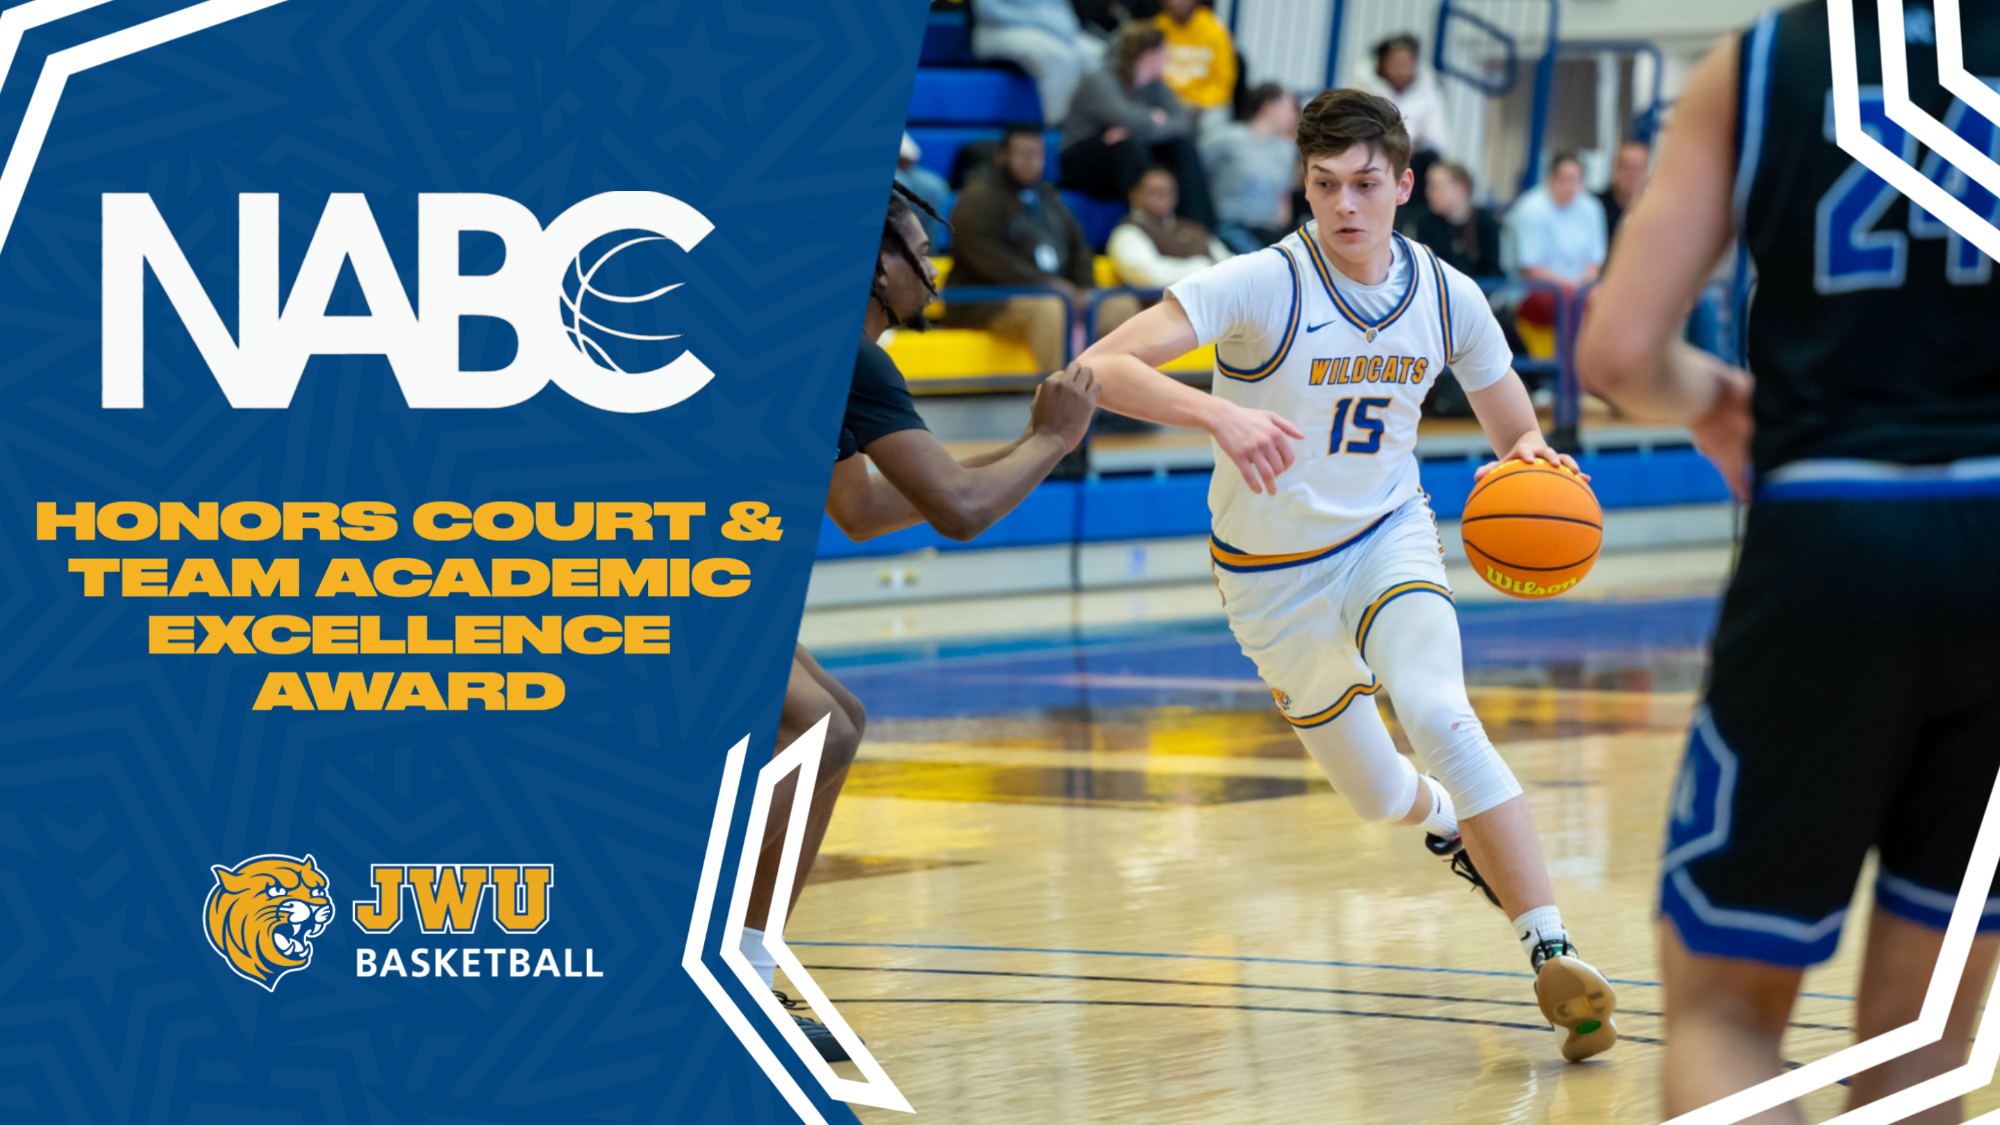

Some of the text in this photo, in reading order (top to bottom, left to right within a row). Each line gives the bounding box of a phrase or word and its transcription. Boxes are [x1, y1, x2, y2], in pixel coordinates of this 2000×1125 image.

[1309, 355, 1429, 385] WILDCATS
[1327, 396, 1393, 456] 15
[1486, 564, 1577, 595] Wilson
